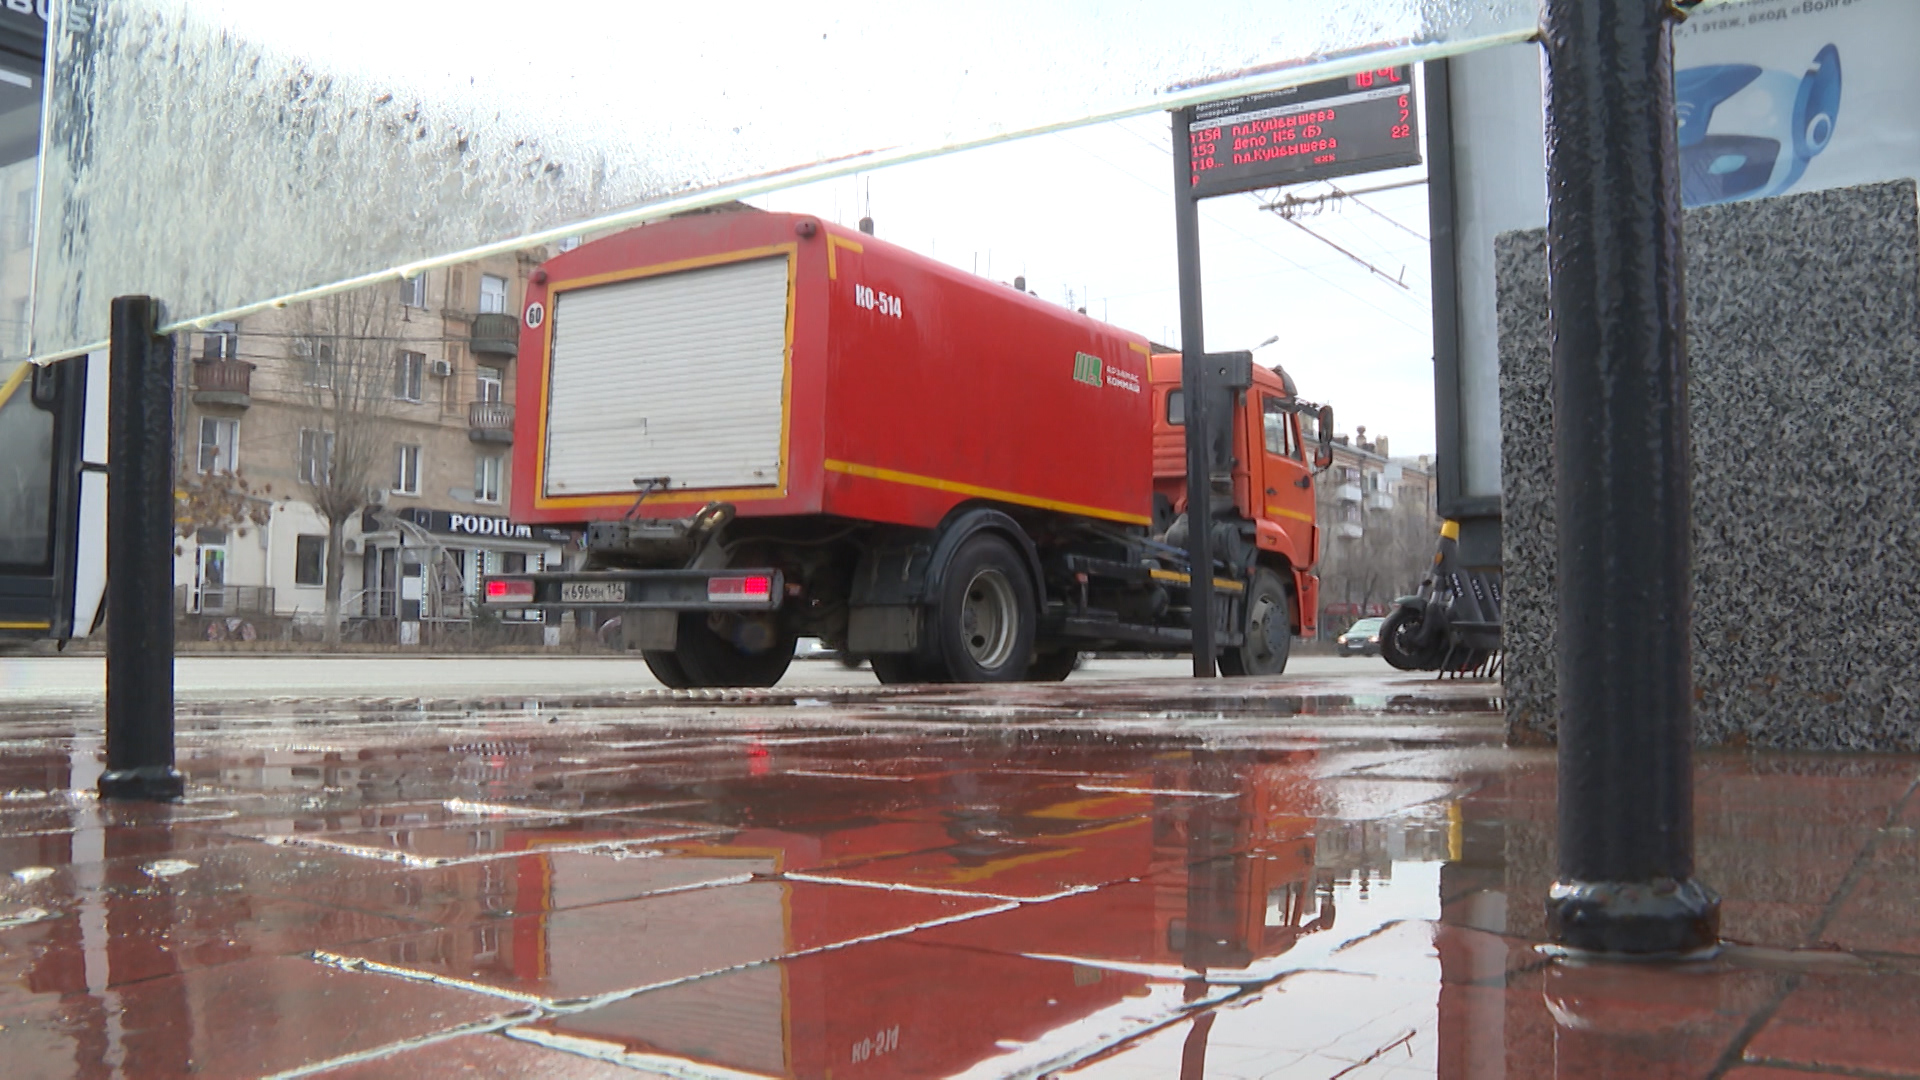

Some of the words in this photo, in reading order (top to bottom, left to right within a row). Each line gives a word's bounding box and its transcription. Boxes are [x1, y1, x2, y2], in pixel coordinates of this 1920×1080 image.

[1748, 8, 1787, 25] вход
[1398, 95, 1408, 107] 6
[1192, 143, 1216, 158] 153
[1233, 135, 1267, 151] Депо
[1399, 109, 1409, 121] 7
[1391, 124, 1410, 138] 22
[855, 283, 902, 319] КО-514
[529, 307, 541, 324] 60
[449, 513, 533, 538] PODIUM
